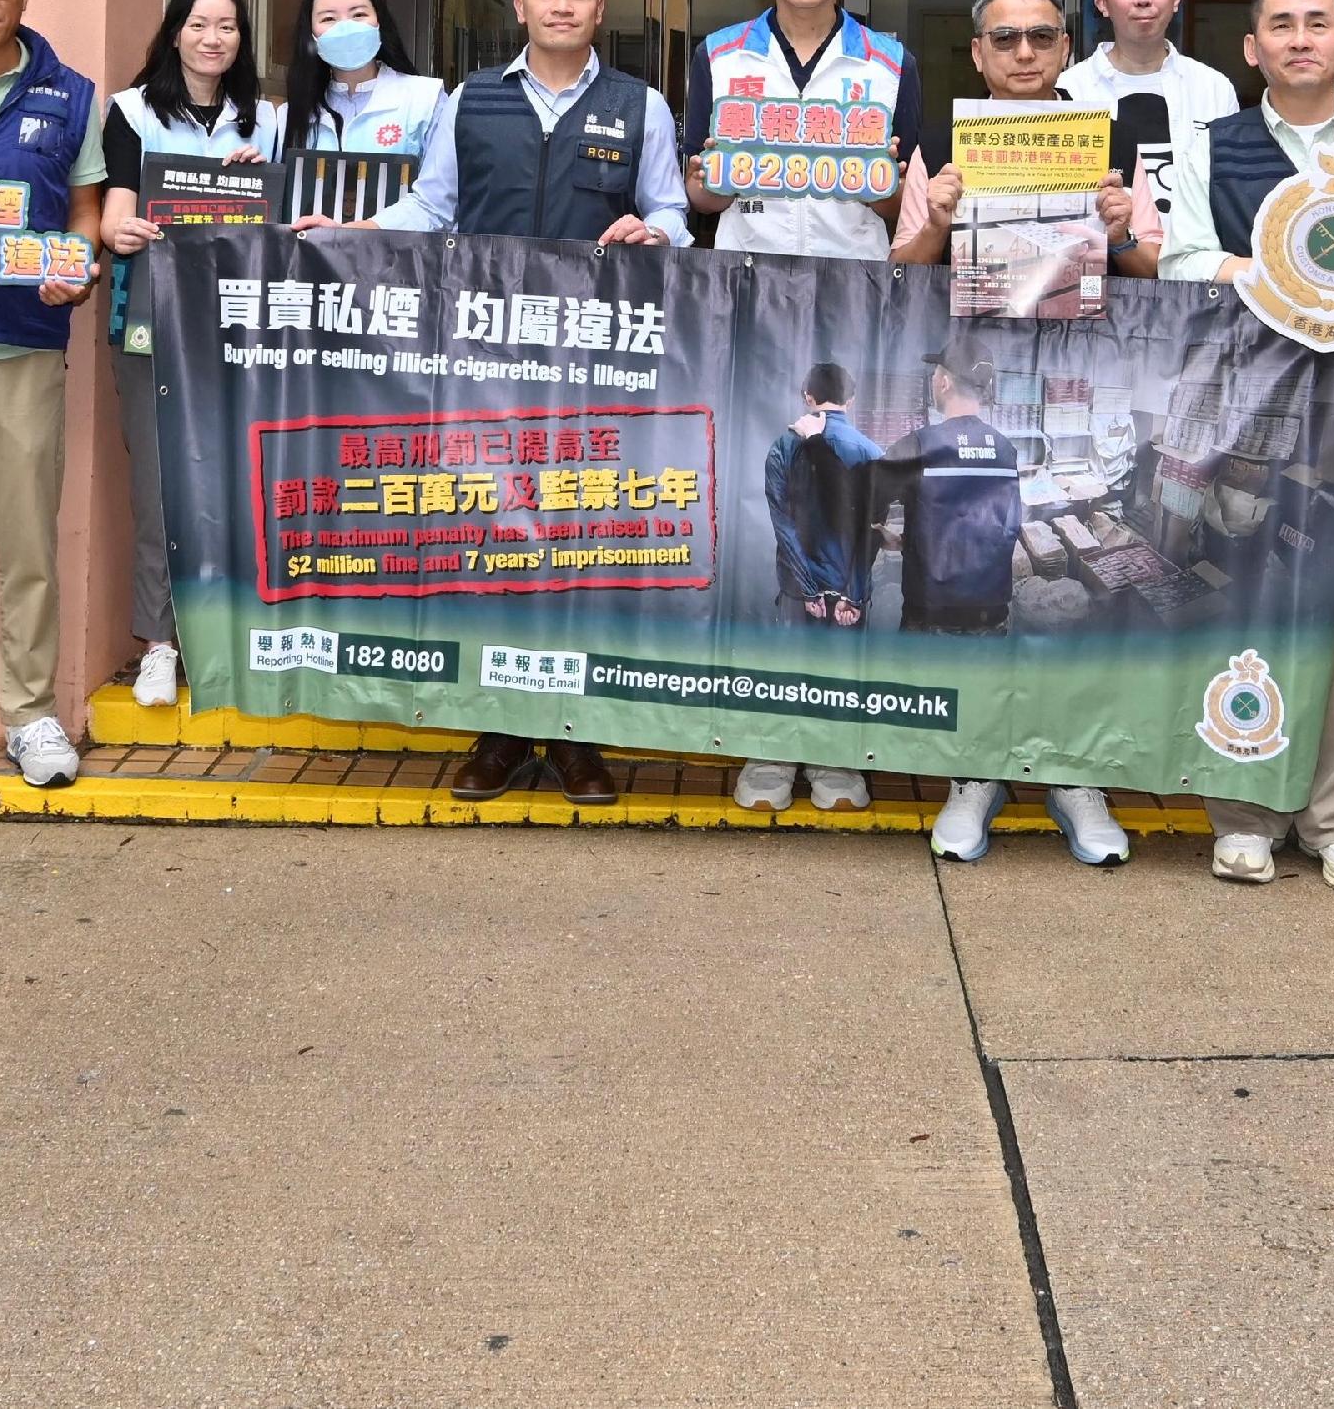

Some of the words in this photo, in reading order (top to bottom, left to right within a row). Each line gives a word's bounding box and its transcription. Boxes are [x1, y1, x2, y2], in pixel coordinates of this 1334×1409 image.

[718, 102, 884, 146] 舉報熱線
[588, 147, 620, 161] RCIB
[705, 152, 892, 191] 1828080
[218, 278, 421, 338] 買賣私煙
[453, 293, 666, 355] 均屬違法
[224, 343, 288, 369] Buying
[293, 348, 317, 365] or
[321, 349, 387, 377] selling
[393, 352, 448, 375] illicit
[454, 356, 562, 384] cigarettes
[568, 361, 588, 384] is
[593, 366, 657, 391] illegal
[339, 426, 620, 468] 最高刑罰已提高至
[272, 466, 699, 520] 罰款二百萬元及監禁七年
[279, 528, 314, 550] The
[319, 526, 409, 548] maximum
[414, 523, 486, 550] penalty
[491, 522, 528, 543] has
[533, 520, 581, 540] been
[587, 517, 646, 540] raised
[653, 518, 673, 538] to
[678, 520, 692, 537] a
[287, 555, 312, 578] $2
[316, 554, 376, 575] million
[381, 552, 418, 573] fine
[423, 551, 461, 572] and
[465, 550, 479, 570] 7
[551, 544, 690, 571] imprisonment
[257, 653, 303, 668] Reporting
[306, 654, 335, 668] Hotline
[258, 633, 333, 654] 舉報熱線
[345, 646, 384, 666] 182
[391, 649, 445, 673] 8080
[491, 651, 581, 674] 舉報電郵
[489, 671, 544, 689] Reporting
[548, 676, 580, 689] Email
[592, 664, 949, 716] crimereport@customs.gov.hk
